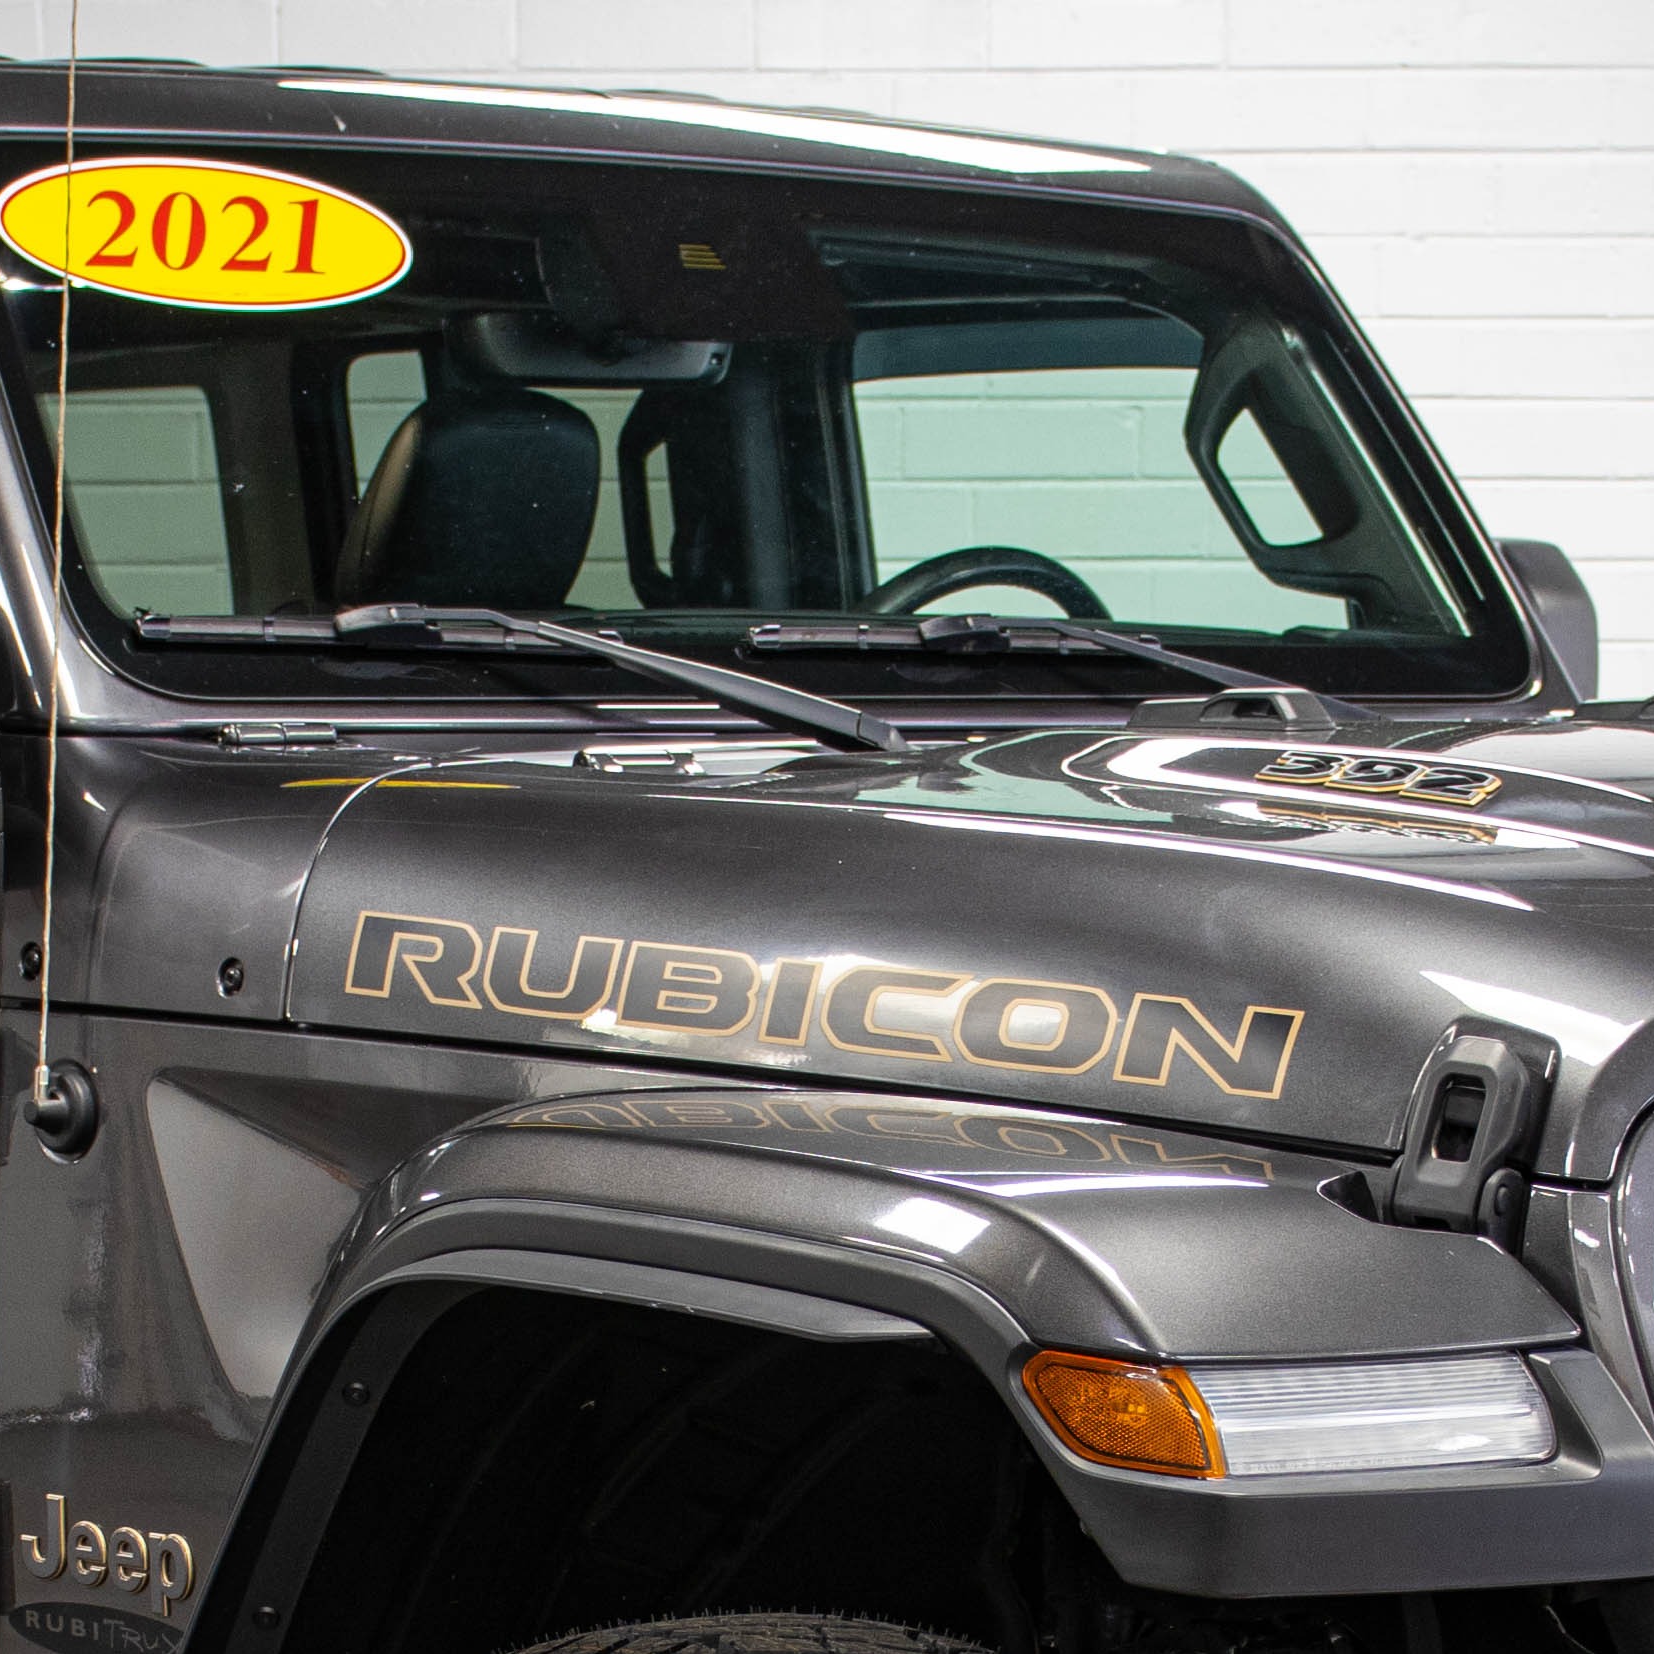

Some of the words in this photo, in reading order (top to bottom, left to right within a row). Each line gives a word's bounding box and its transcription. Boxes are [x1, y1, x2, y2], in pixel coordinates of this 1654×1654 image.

[84, 190, 326, 275] 2021
[1254, 750, 1503, 807] 392
[344, 910, 1305, 1100] RUBICON
[20, 1492, 194, 1617] Jeep
